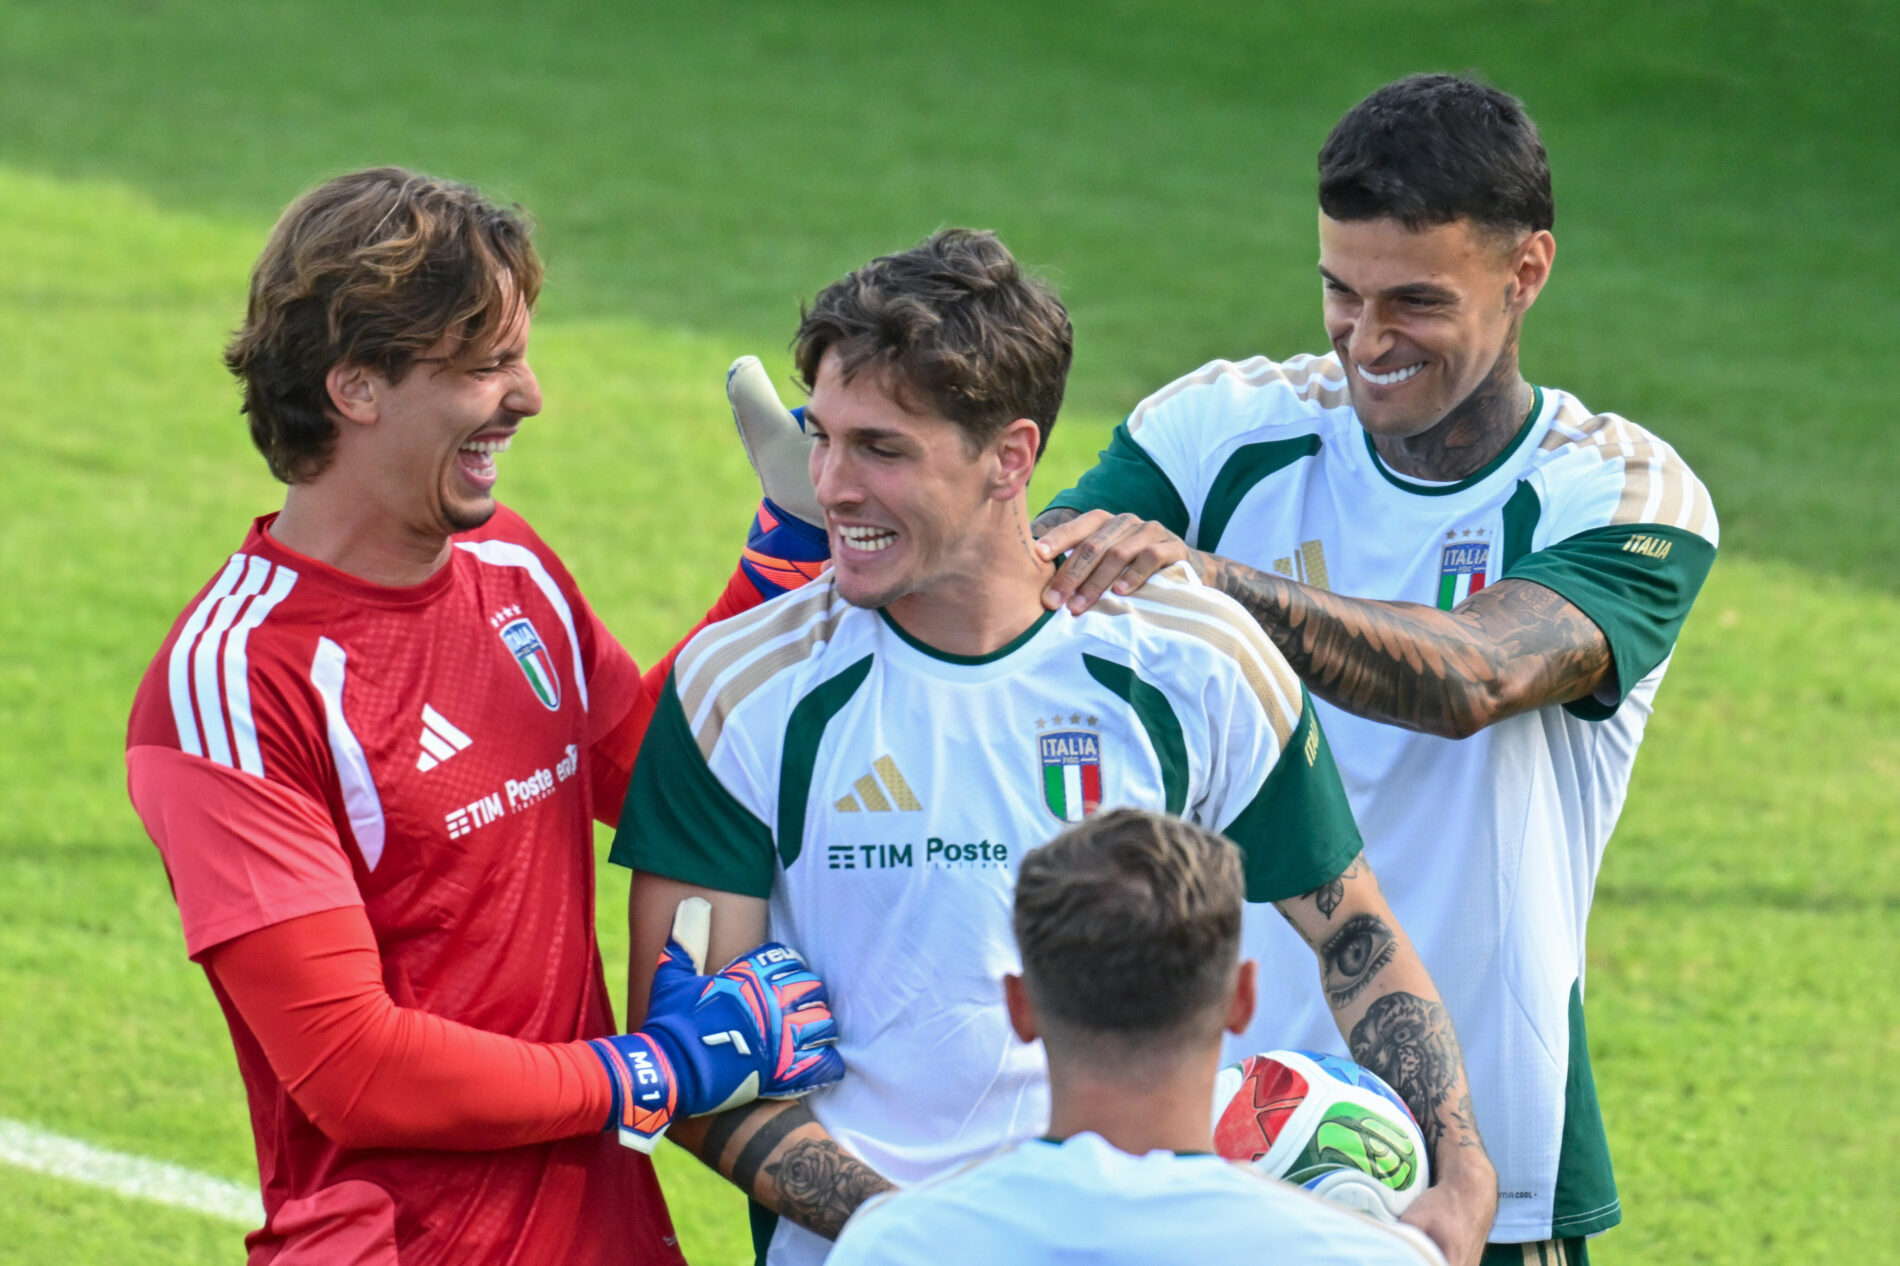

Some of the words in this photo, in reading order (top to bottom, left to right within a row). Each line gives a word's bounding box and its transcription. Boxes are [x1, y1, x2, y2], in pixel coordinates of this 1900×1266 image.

[1444, 549, 1489, 566] ITALIA
[1622, 535, 1672, 560] ITALIA
[1042, 737, 1097, 756] ITALIA
[467, 791, 505, 828] TIM
[504, 768, 554, 807] Poste
[860, 844, 913, 869] TIM
[926, 837, 1008, 862] Poste
[628, 1051, 658, 1085] MC
[642, 1090, 661, 1101] 1
